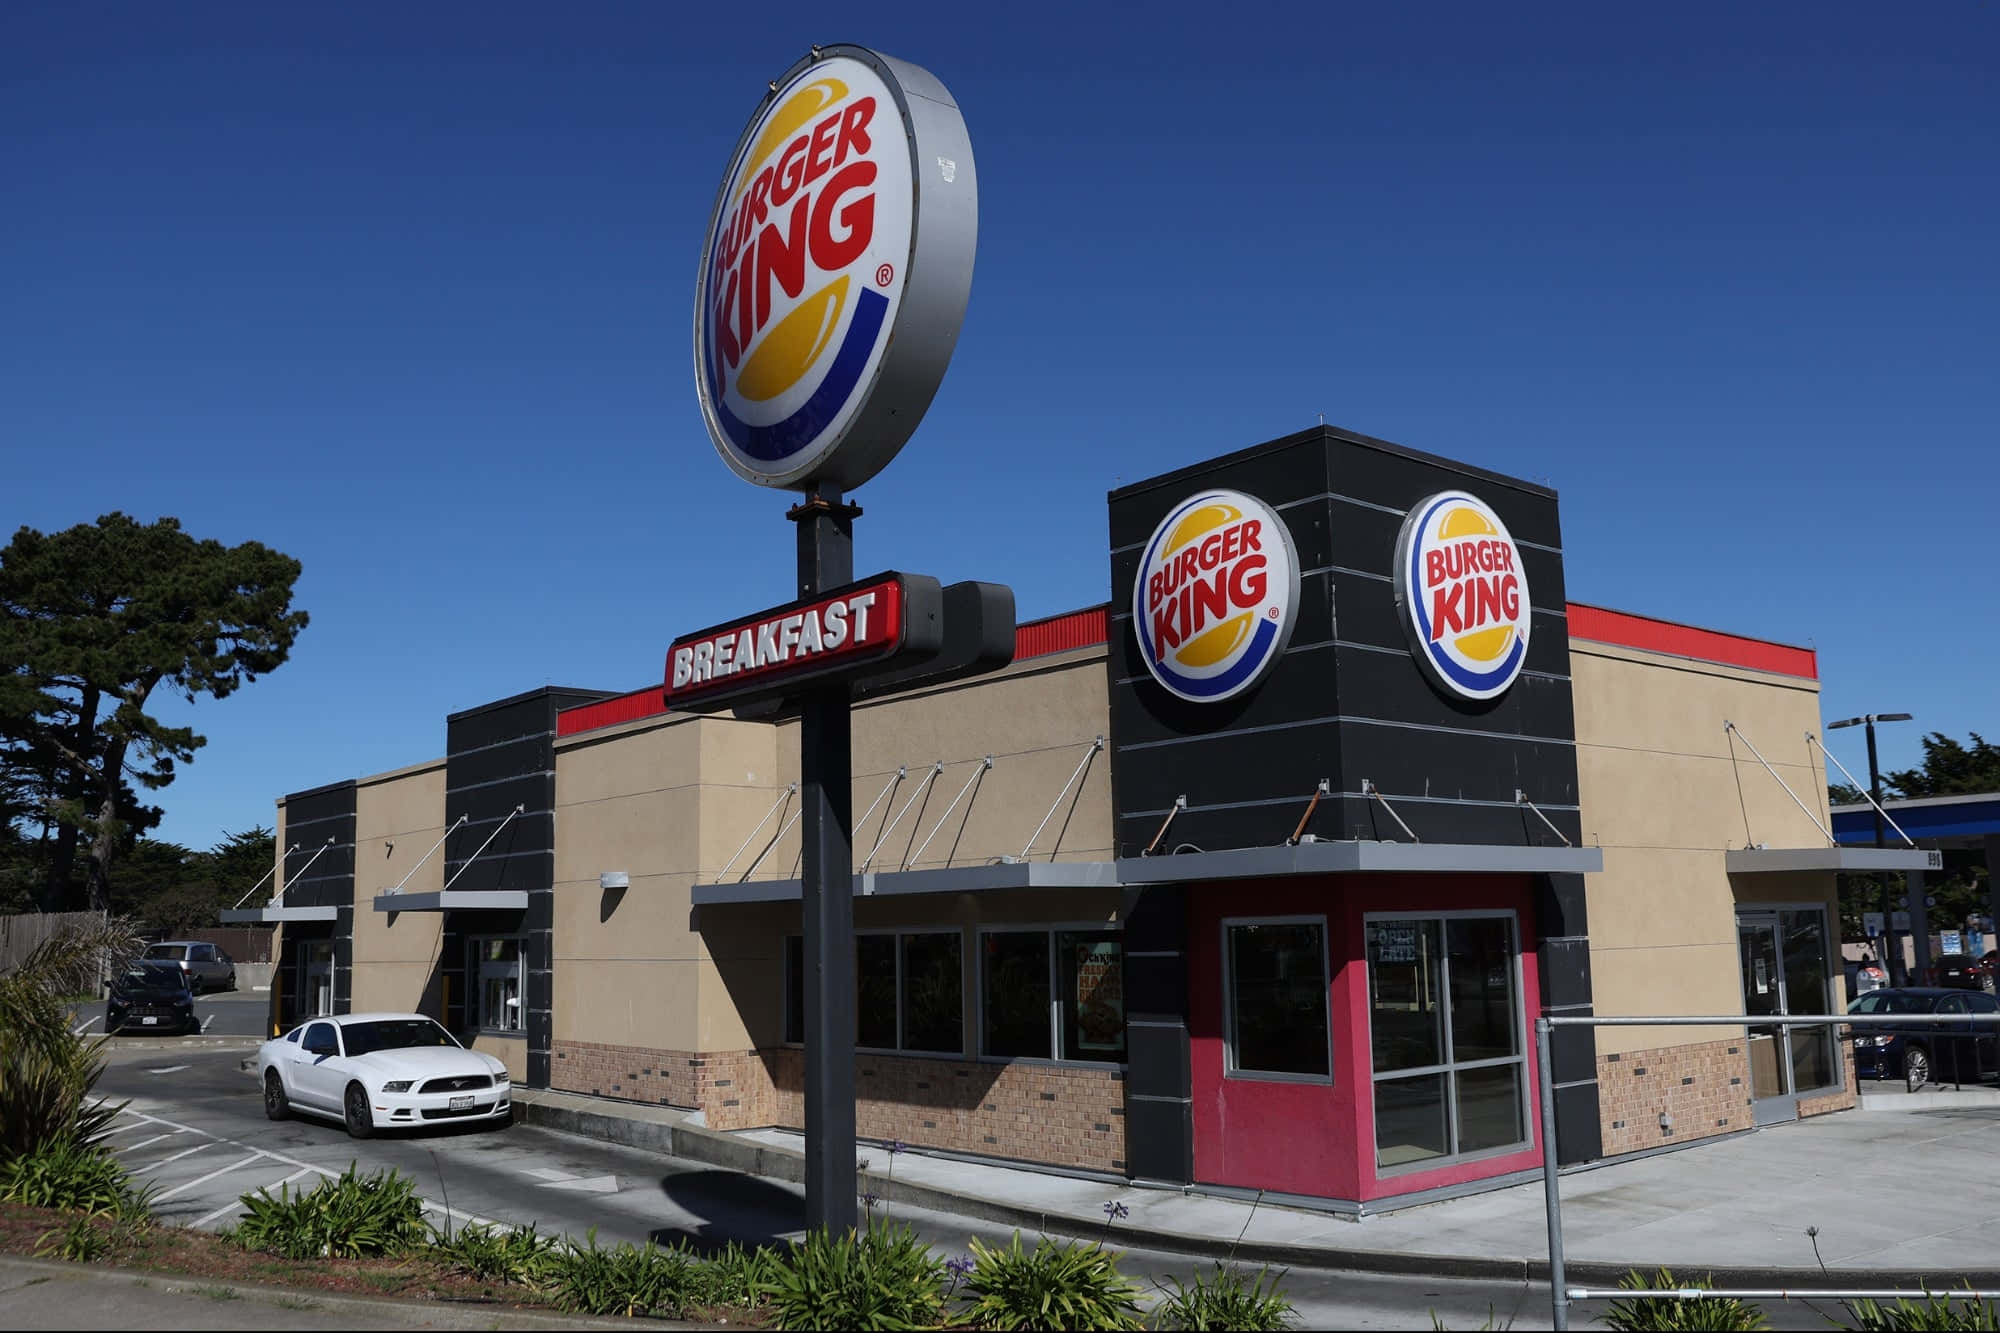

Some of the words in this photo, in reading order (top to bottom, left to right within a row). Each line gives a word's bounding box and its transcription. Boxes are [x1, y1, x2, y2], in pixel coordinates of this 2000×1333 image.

[714, 96, 876, 298] BURGER
[715, 161, 877, 404] KING
[1150, 519, 1262, 612] BURGER
[1154, 554, 1267, 663] KING
[1426, 540, 1514, 588] BURGER
[1432, 574, 1519, 641] KING
[672, 592, 876, 688] BREAKFAST
